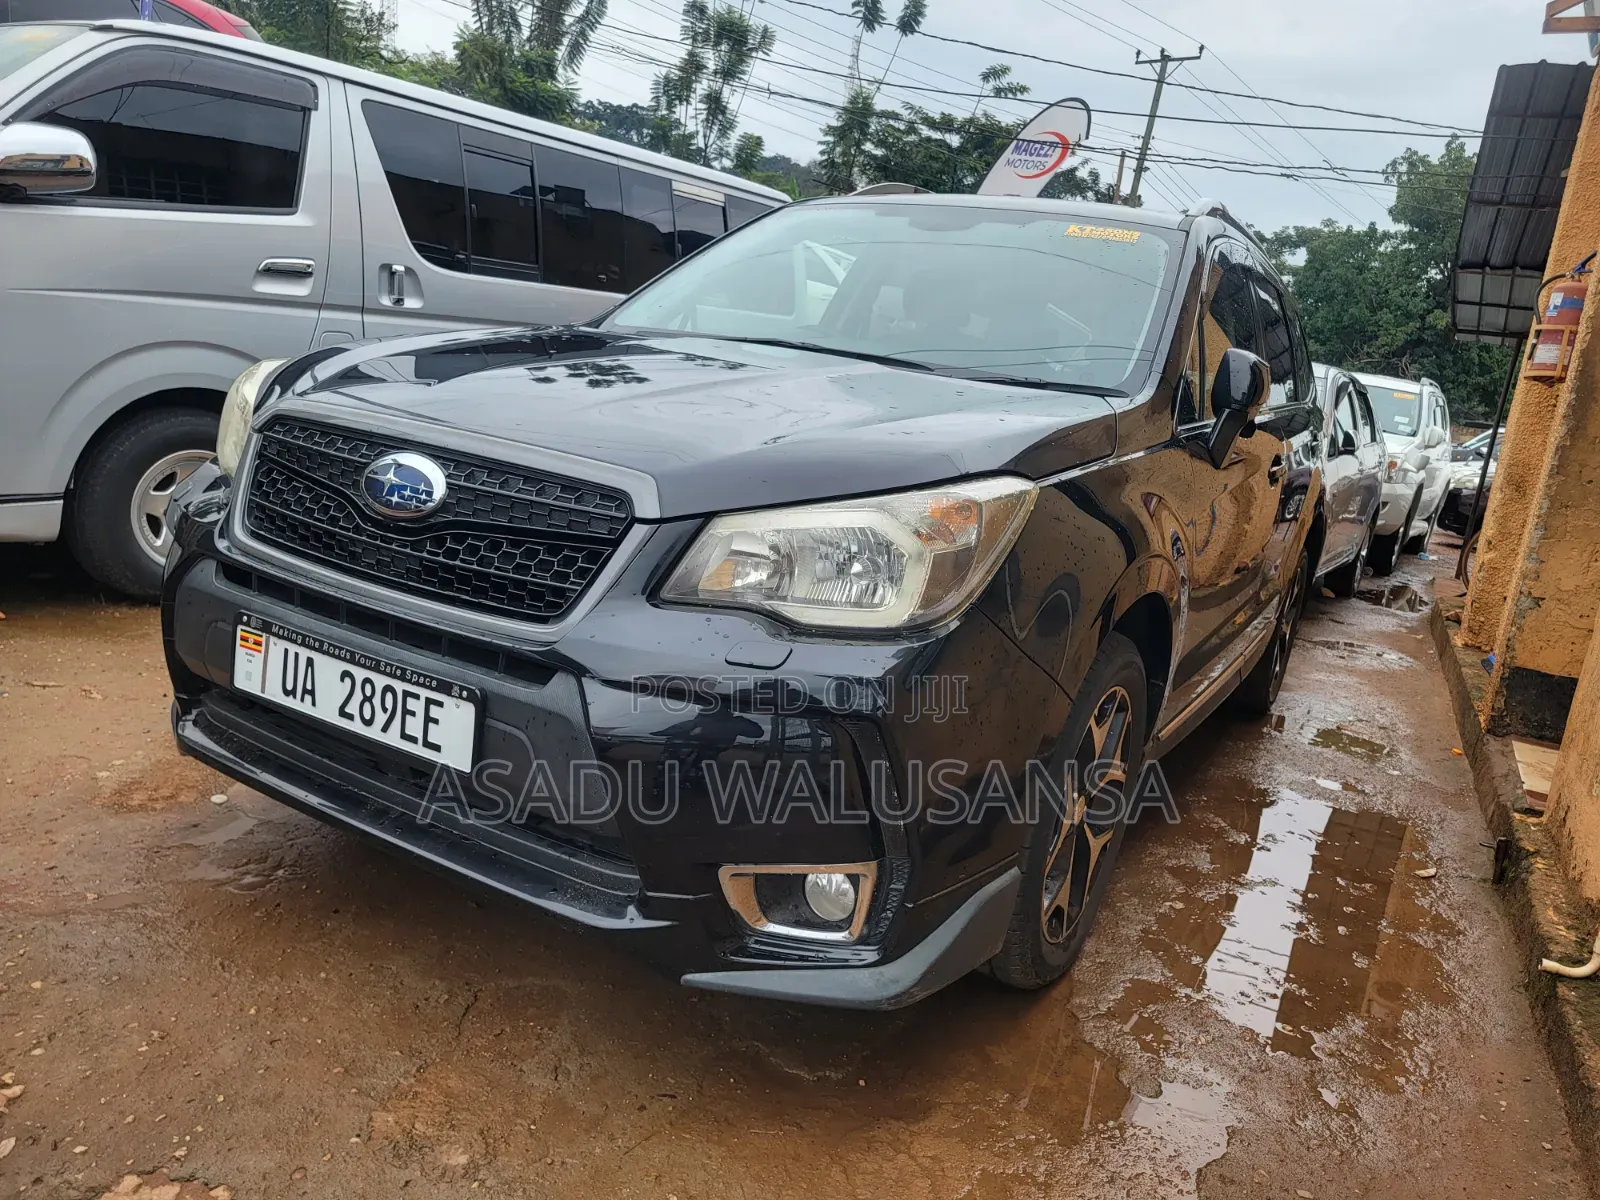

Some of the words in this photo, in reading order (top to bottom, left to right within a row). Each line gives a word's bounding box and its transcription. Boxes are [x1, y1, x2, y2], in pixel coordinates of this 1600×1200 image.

[1004, 158, 1049, 170] MOTORS
[271, 623, 302, 645] Making
[305, 635, 320, 648] the
[322, 638, 351, 660] Roads
[354, 653, 376, 668] Your
[379, 662, 402, 677] Safe
[405, 670, 438, 688] Space
[281, 647, 317, 708] UA
[338, 669, 445, 753] 289EE
